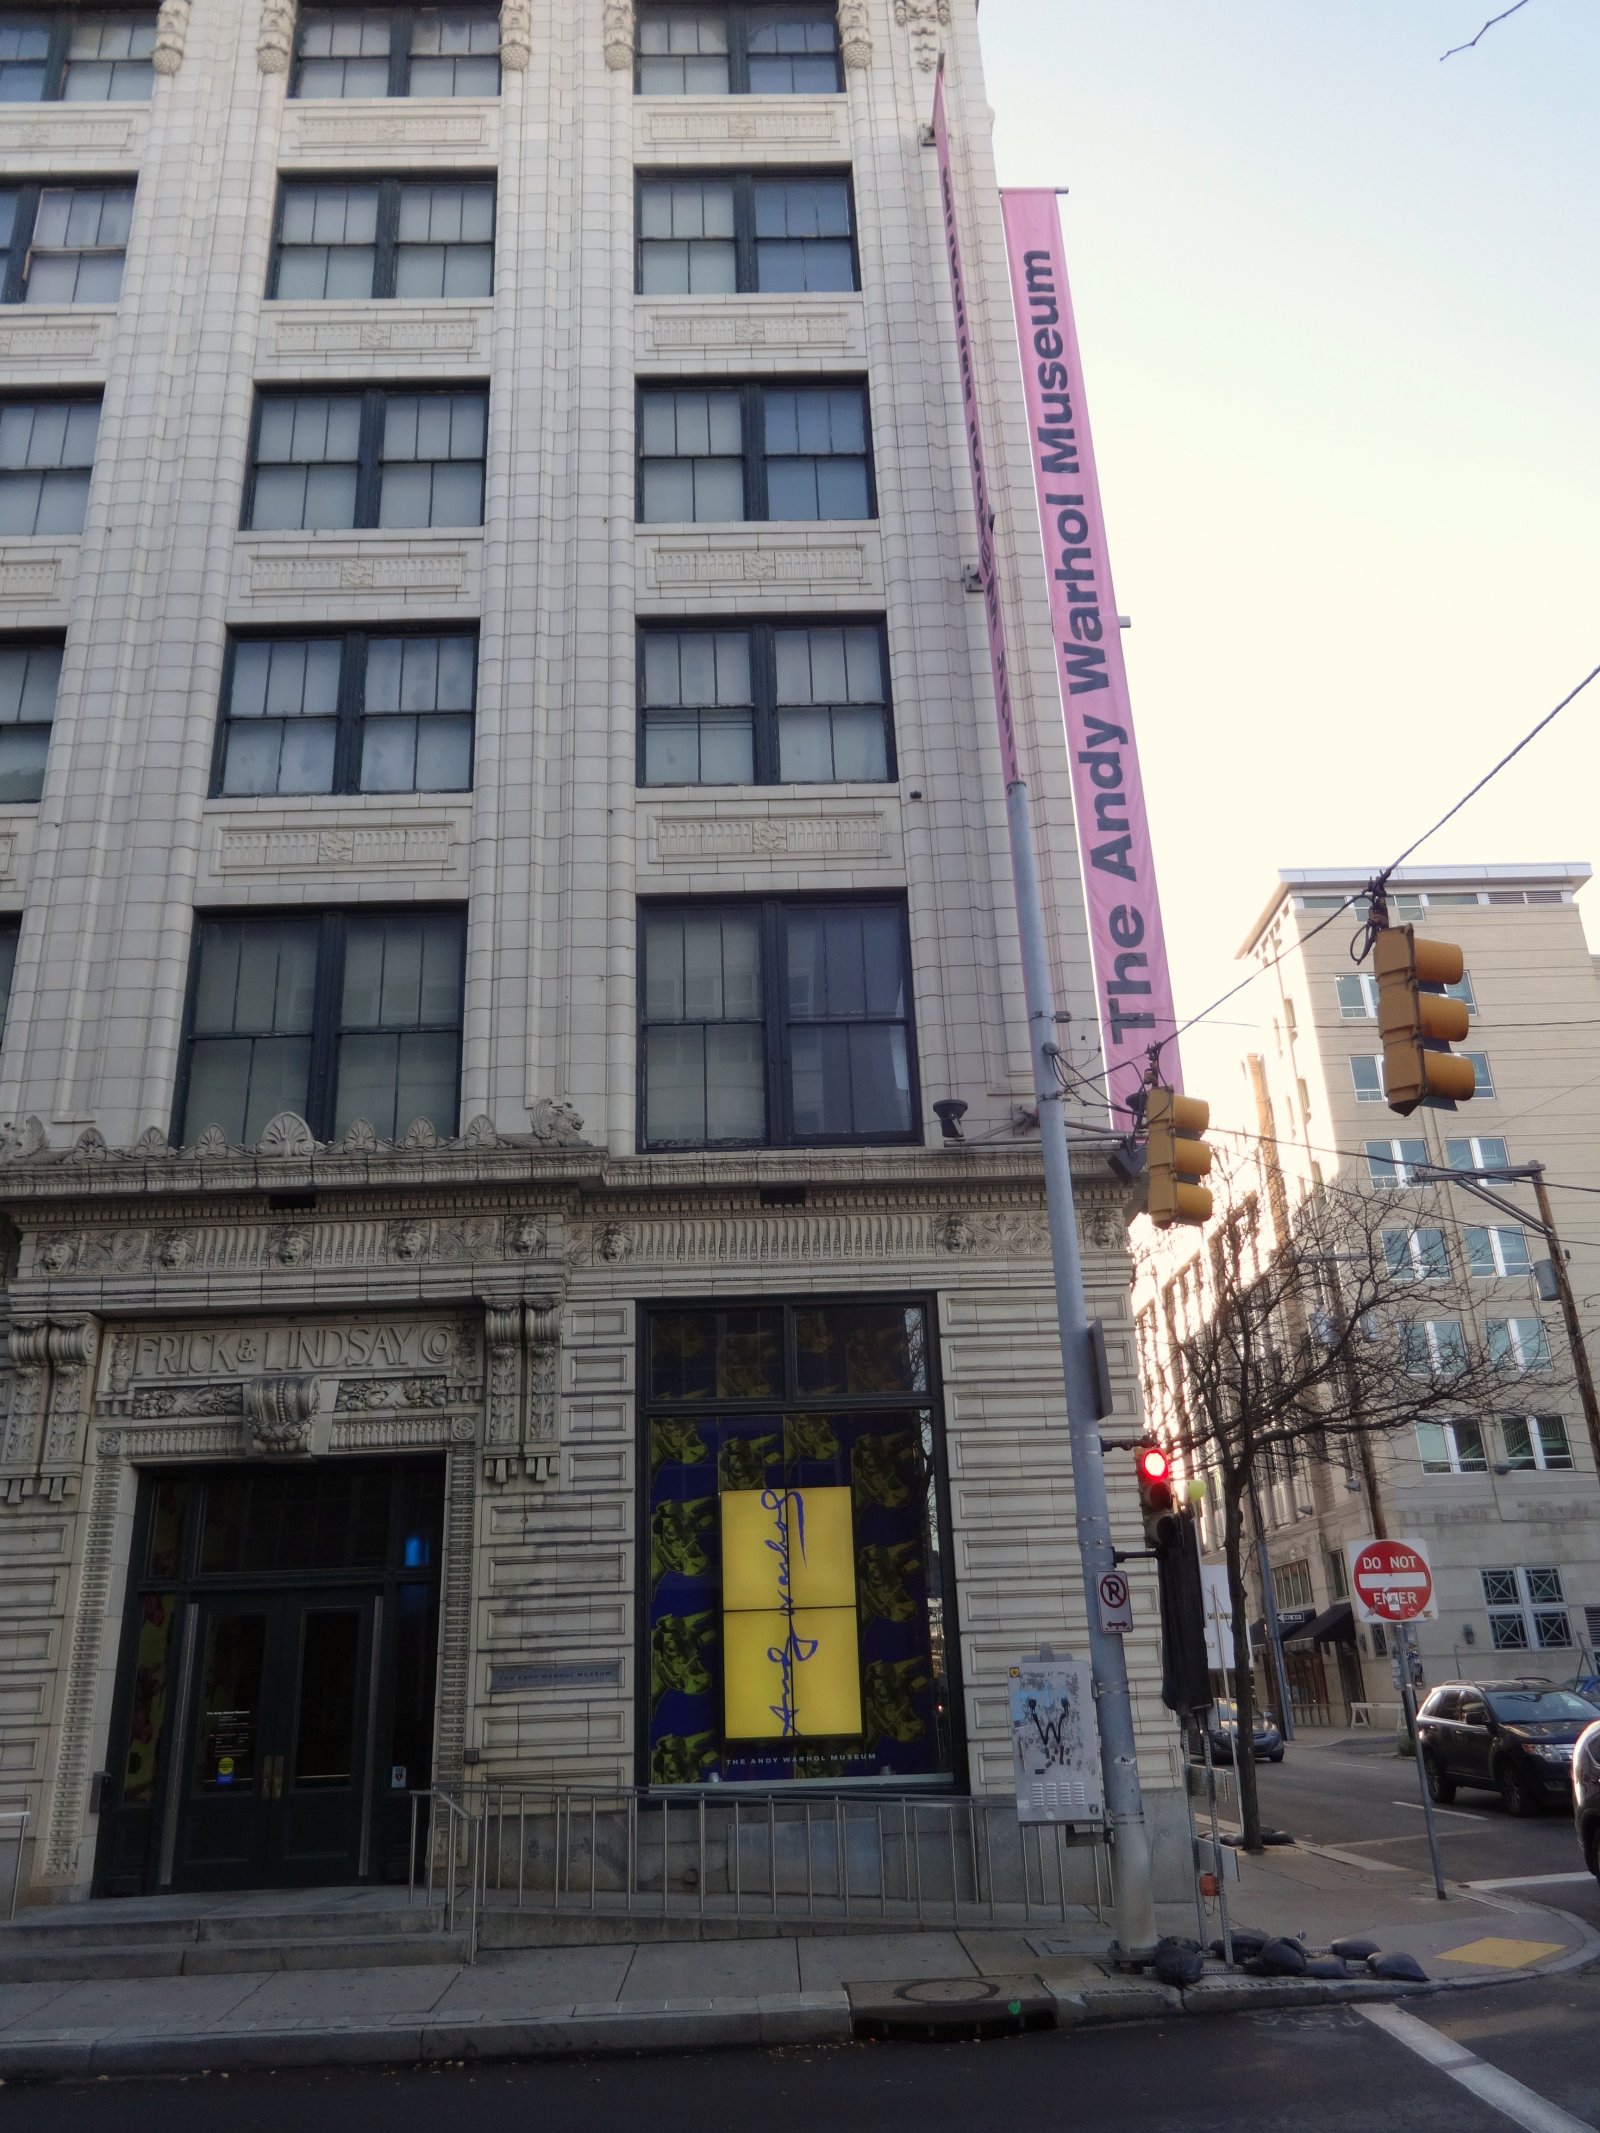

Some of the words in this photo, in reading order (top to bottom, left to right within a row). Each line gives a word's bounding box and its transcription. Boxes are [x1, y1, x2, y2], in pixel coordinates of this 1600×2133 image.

[1023, 250, 1080, 475] Museum
[1045, 494, 1109, 696] Warhol
[1078, 714, 1137, 883] Andy
[1105, 905, 1157, 1046] The
[132, 1331, 238, 1376] FRICK
[237, 1336, 256, 1363] &
[263, 1325, 417, 1371] LINDSAY
[1362, 1556, 1381, 1569] DO
[1389, 1555, 1416, 1569] NOT
[1373, 1591, 1417, 1605] ENER
[782, 1755, 826, 1763] WARHOL
[830, 1753, 876, 1761] MUSEUM
